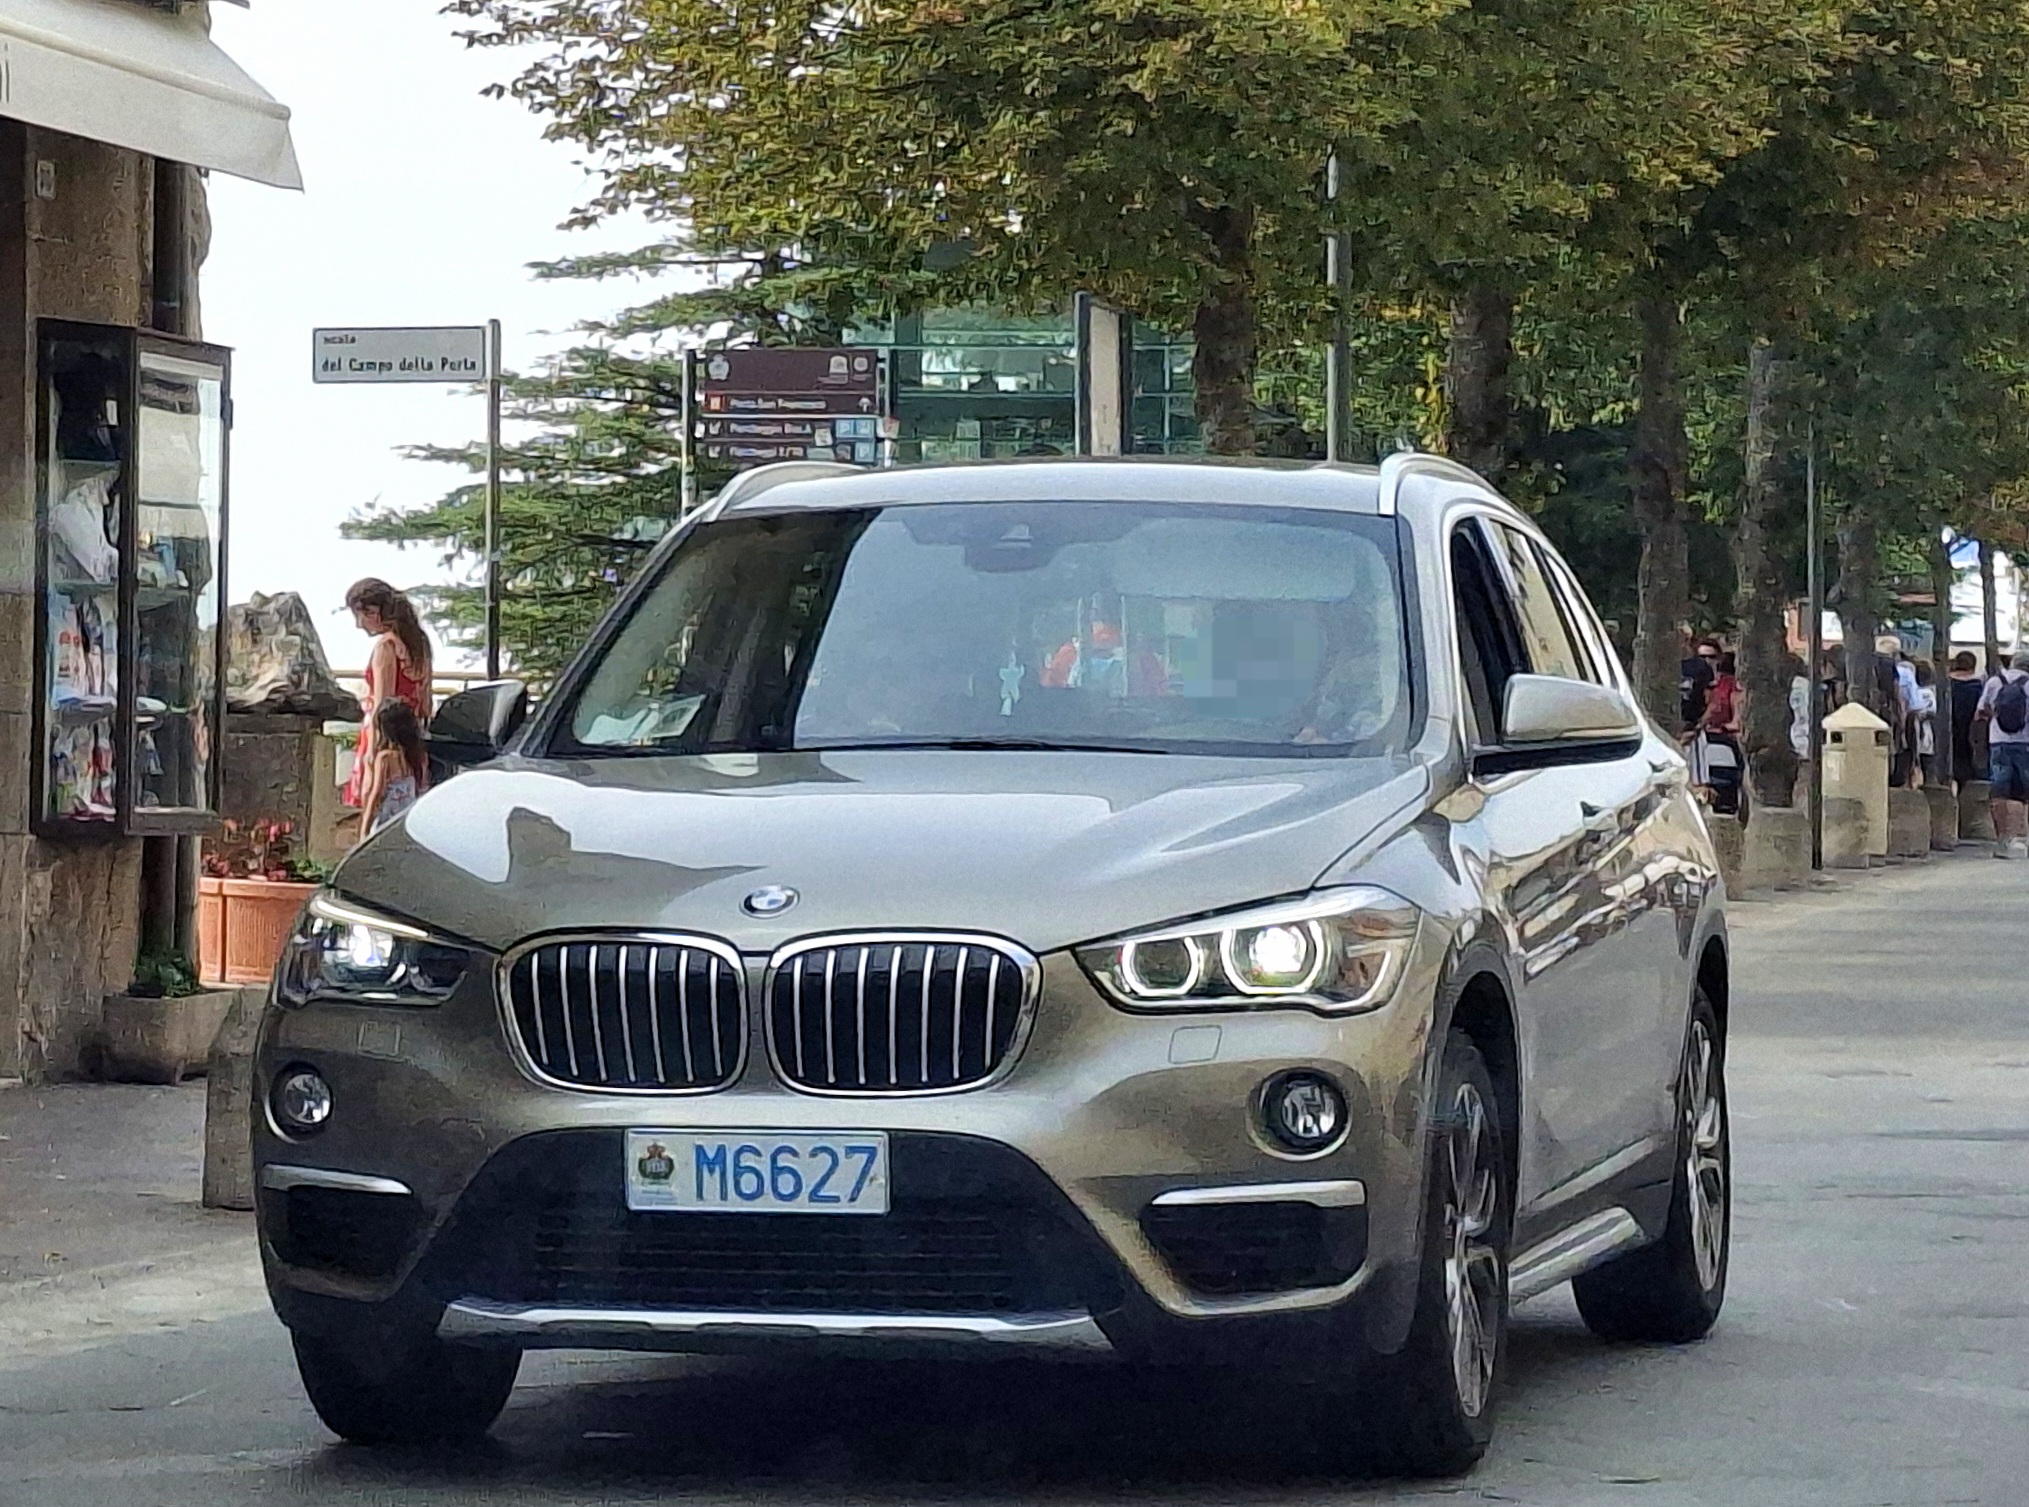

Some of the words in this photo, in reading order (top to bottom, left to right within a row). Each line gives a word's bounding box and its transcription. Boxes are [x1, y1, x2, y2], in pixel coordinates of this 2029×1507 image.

[322, 356, 341, 372] del
[349, 357, 393, 375] Campo
[399, 356, 433, 372] della
[694, 1144, 878, 1203] M6627
